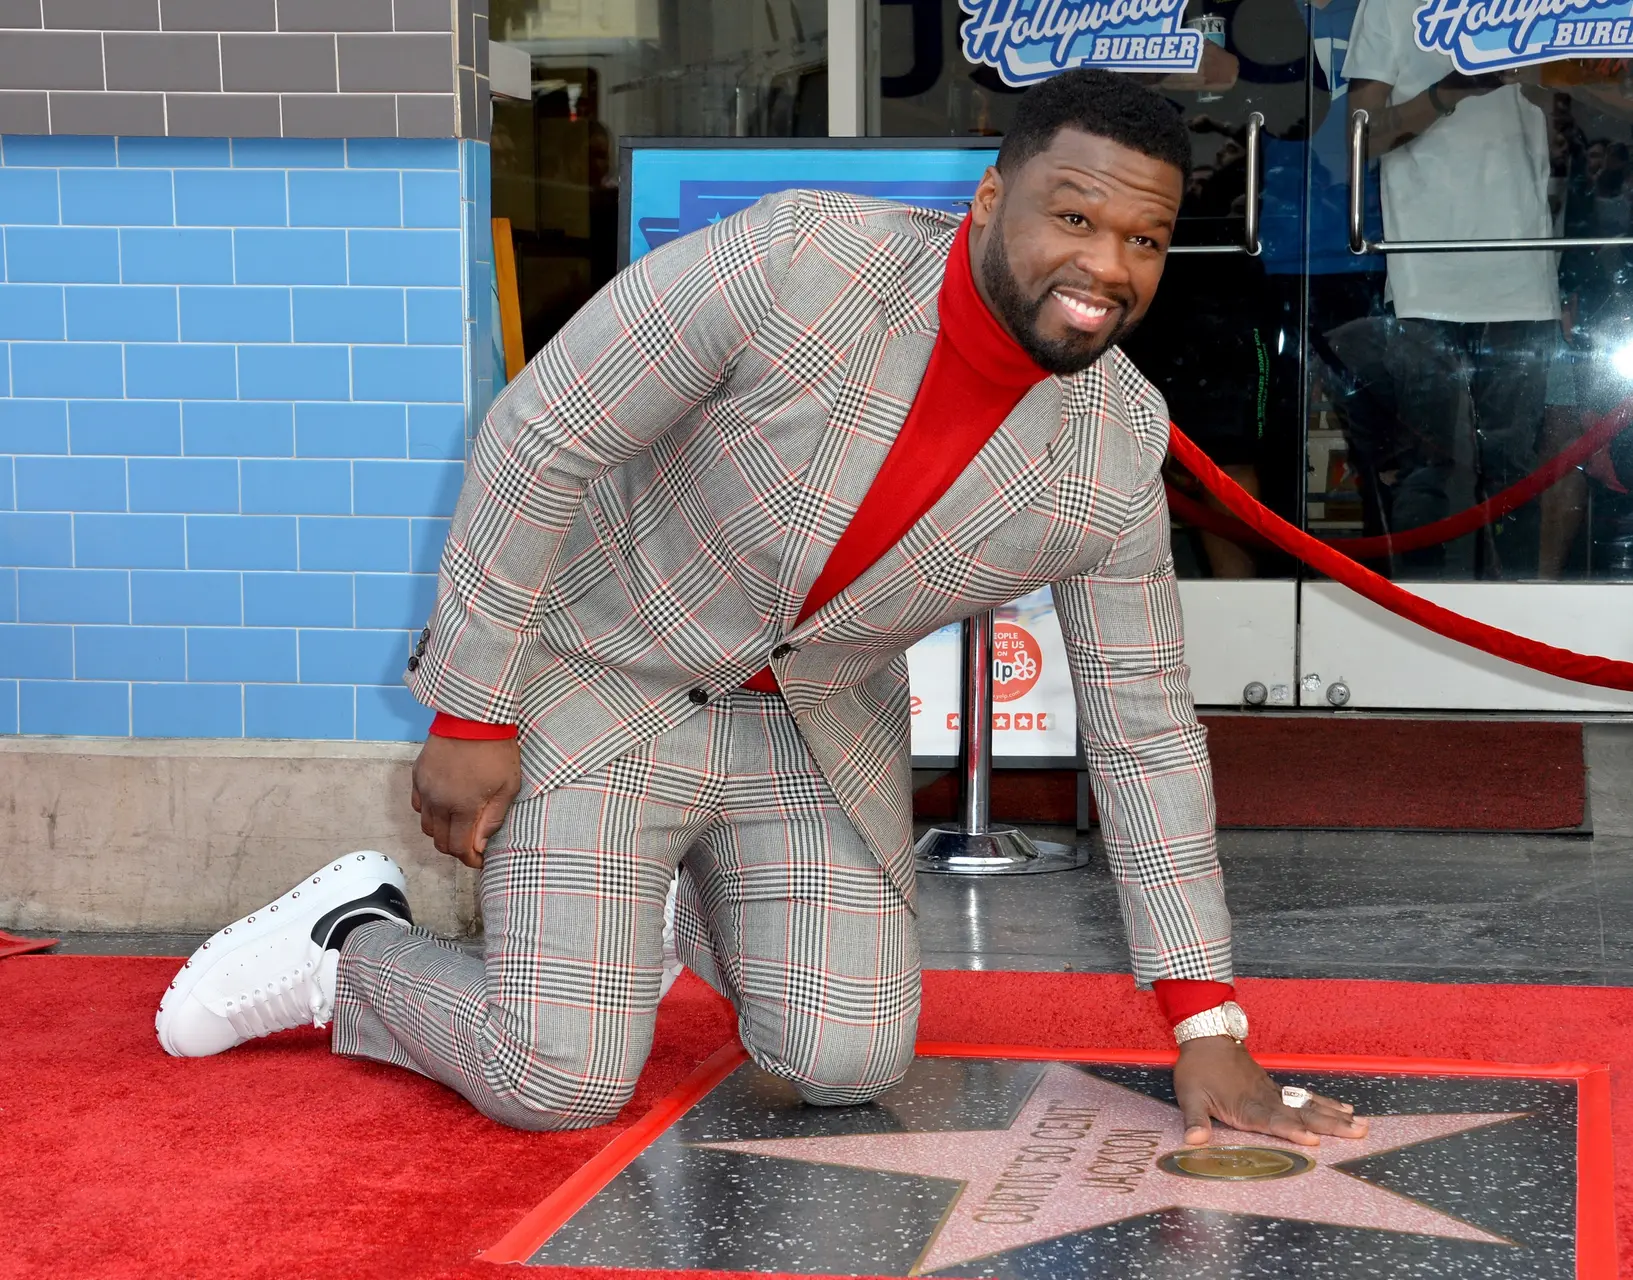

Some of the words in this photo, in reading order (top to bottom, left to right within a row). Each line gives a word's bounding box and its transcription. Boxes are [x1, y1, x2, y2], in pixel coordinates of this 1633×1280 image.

[1553, 20, 1633, 46] BURG
[1091, 36, 1196, 61] BURGER
[994, 632, 1018, 640] EOPLE
[994, 641, 1009, 649] VE
[1011, 640, 1025, 649] US
[995, 661, 1013, 682] lp
[1077, 1128, 1164, 1194] JACKSON
[972, 1170, 1062, 1225] CURTIS
